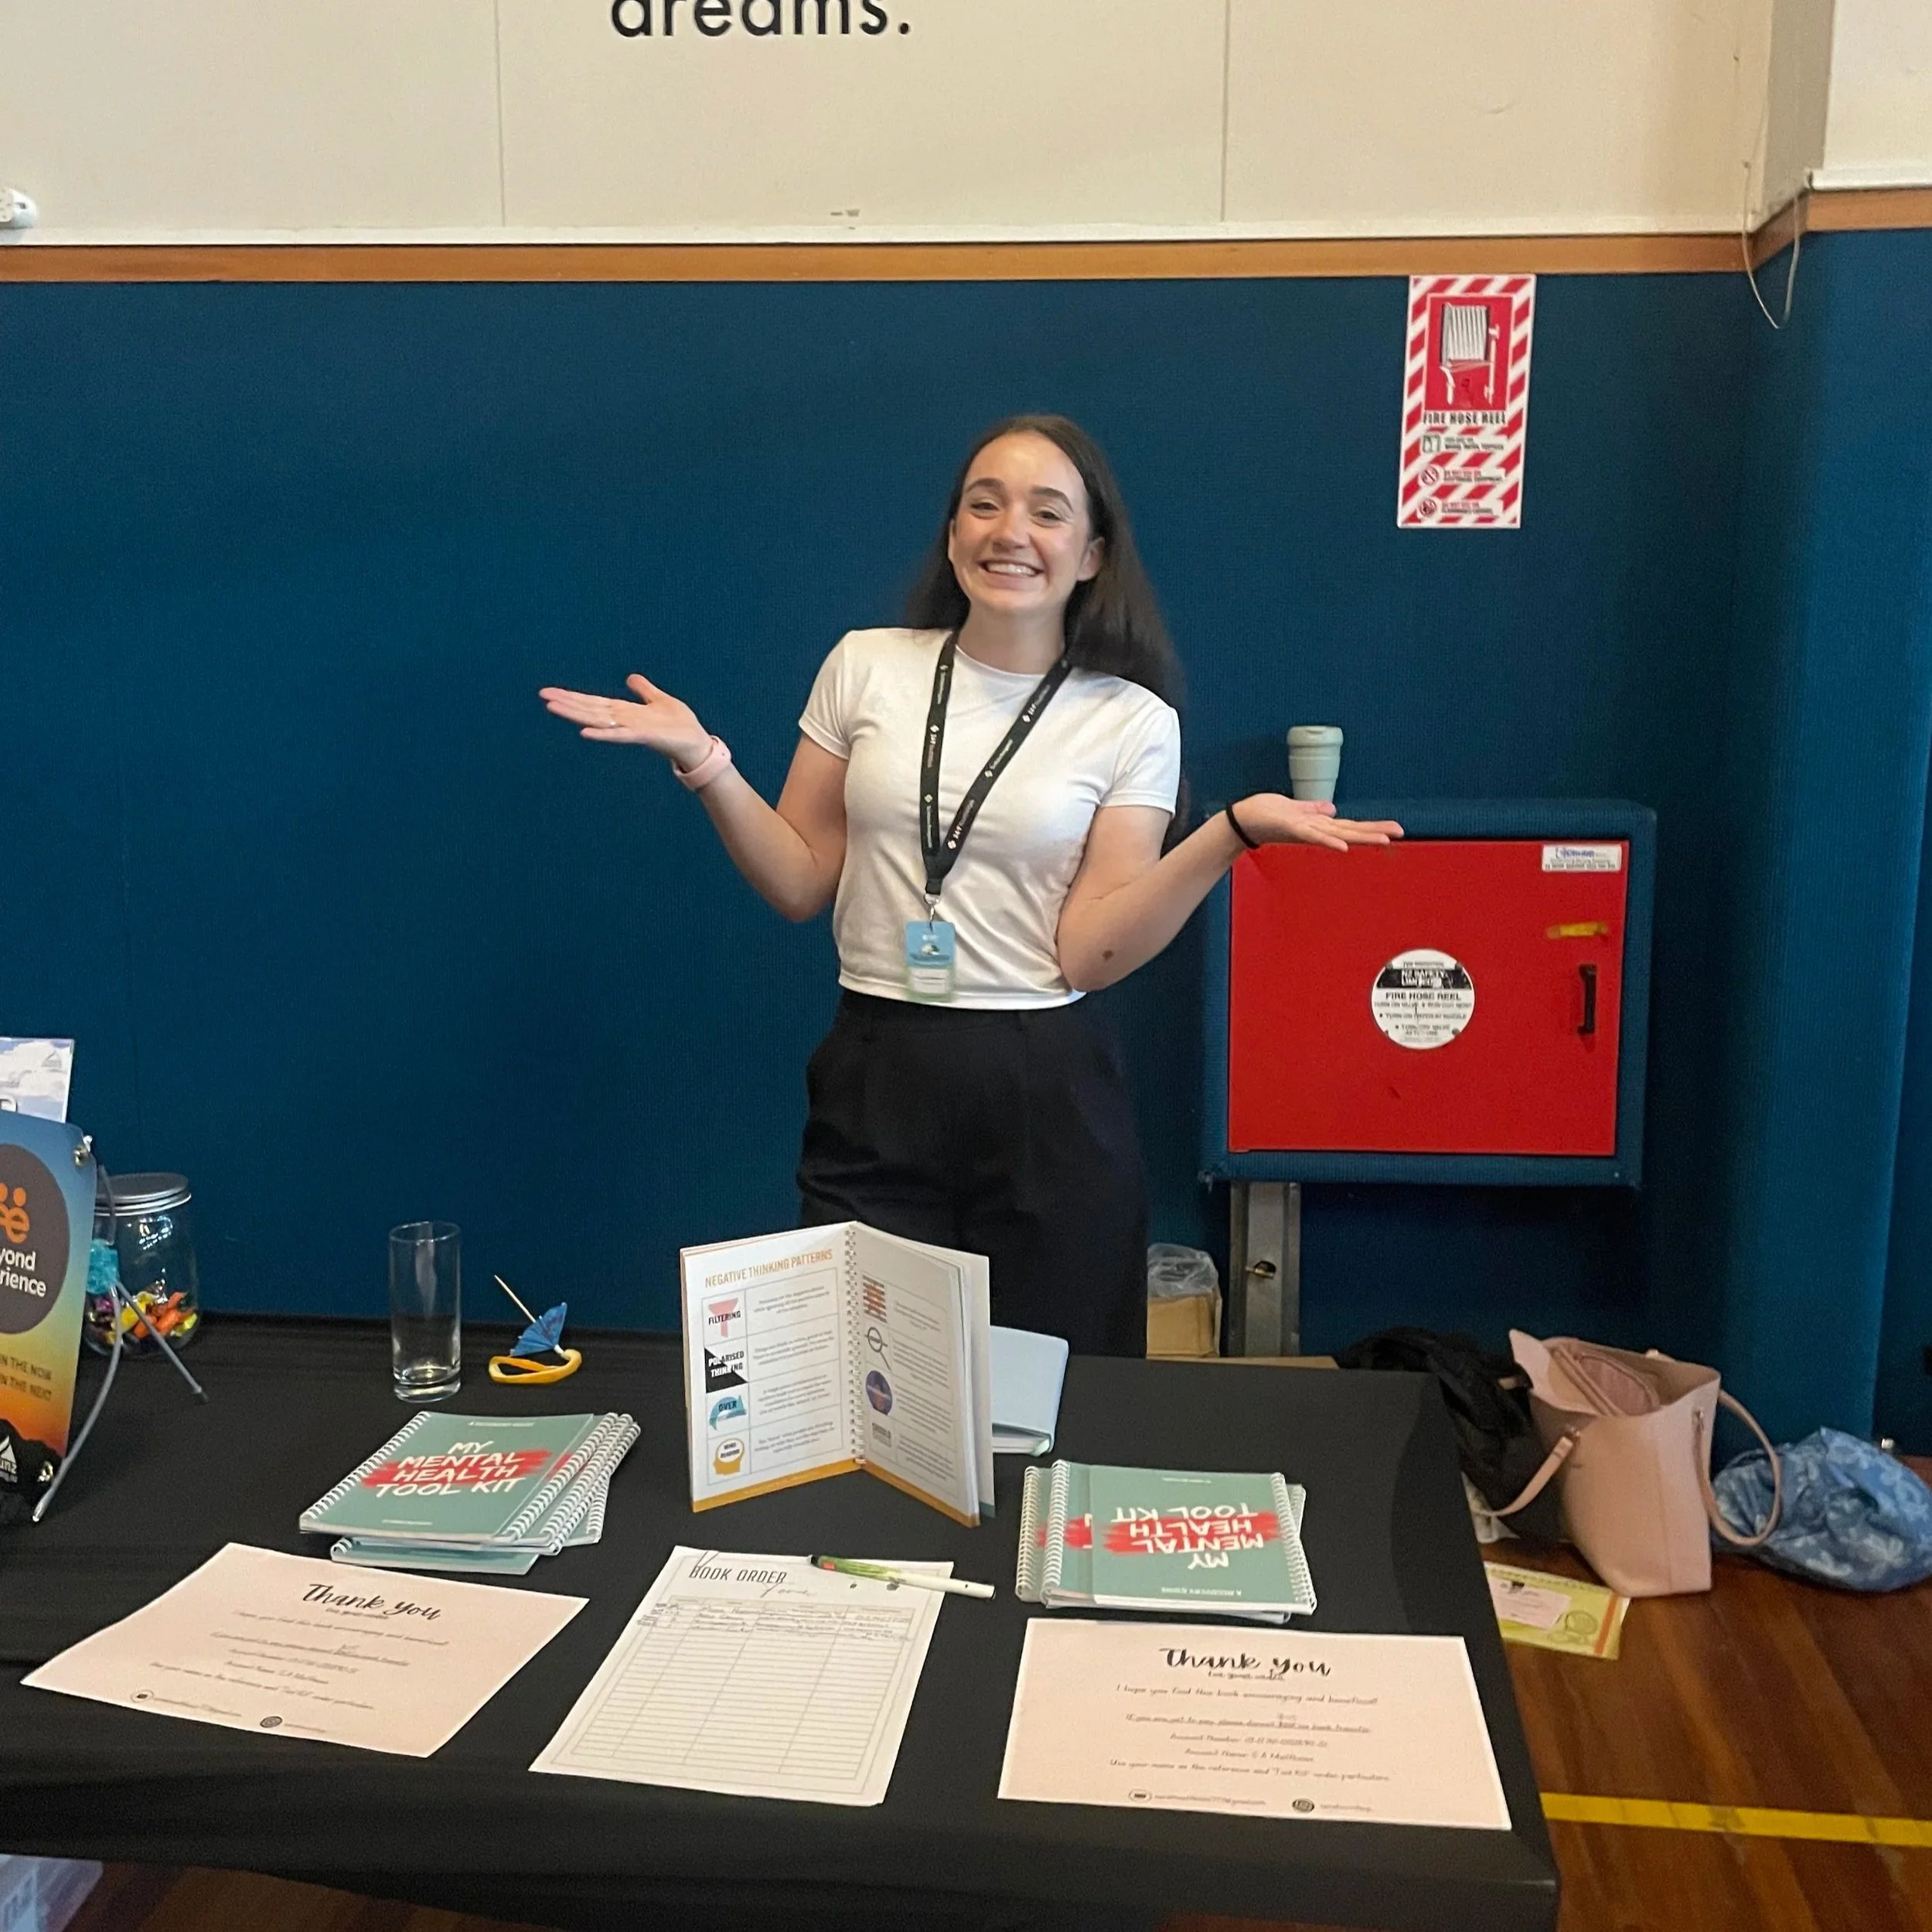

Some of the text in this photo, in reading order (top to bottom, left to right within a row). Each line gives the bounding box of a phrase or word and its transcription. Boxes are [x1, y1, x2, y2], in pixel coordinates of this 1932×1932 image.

[705, 1249, 833, 1288] NEGATIVE THINKING PATTERNS
[708, 1310, 741, 1325] FILTERING
[708, 1351, 745, 1367] POLARISED
[710, 1362, 743, 1378] THINKING
[718, 1401, 737, 1412] OVER
[448, 1440, 495, 1454] MY
[397, 1452, 526, 1469] MENTAL
[392, 1465, 519, 1482] HEALTH
[376, 1477, 526, 1498] TOOL KIT
[1110, 1502, 1259, 1522] TOOL KIT
[1130, 1518, 1252, 1538] HEALTH
[1131, 1533, 1264, 1554] MENTAL
[1187, 1552, 1229, 1569] MY
[688, 1565, 787, 1583] BOOK ORDER
[302, 1583, 385, 1609] Thank
[1159, 1647, 1261, 1669] Thank
